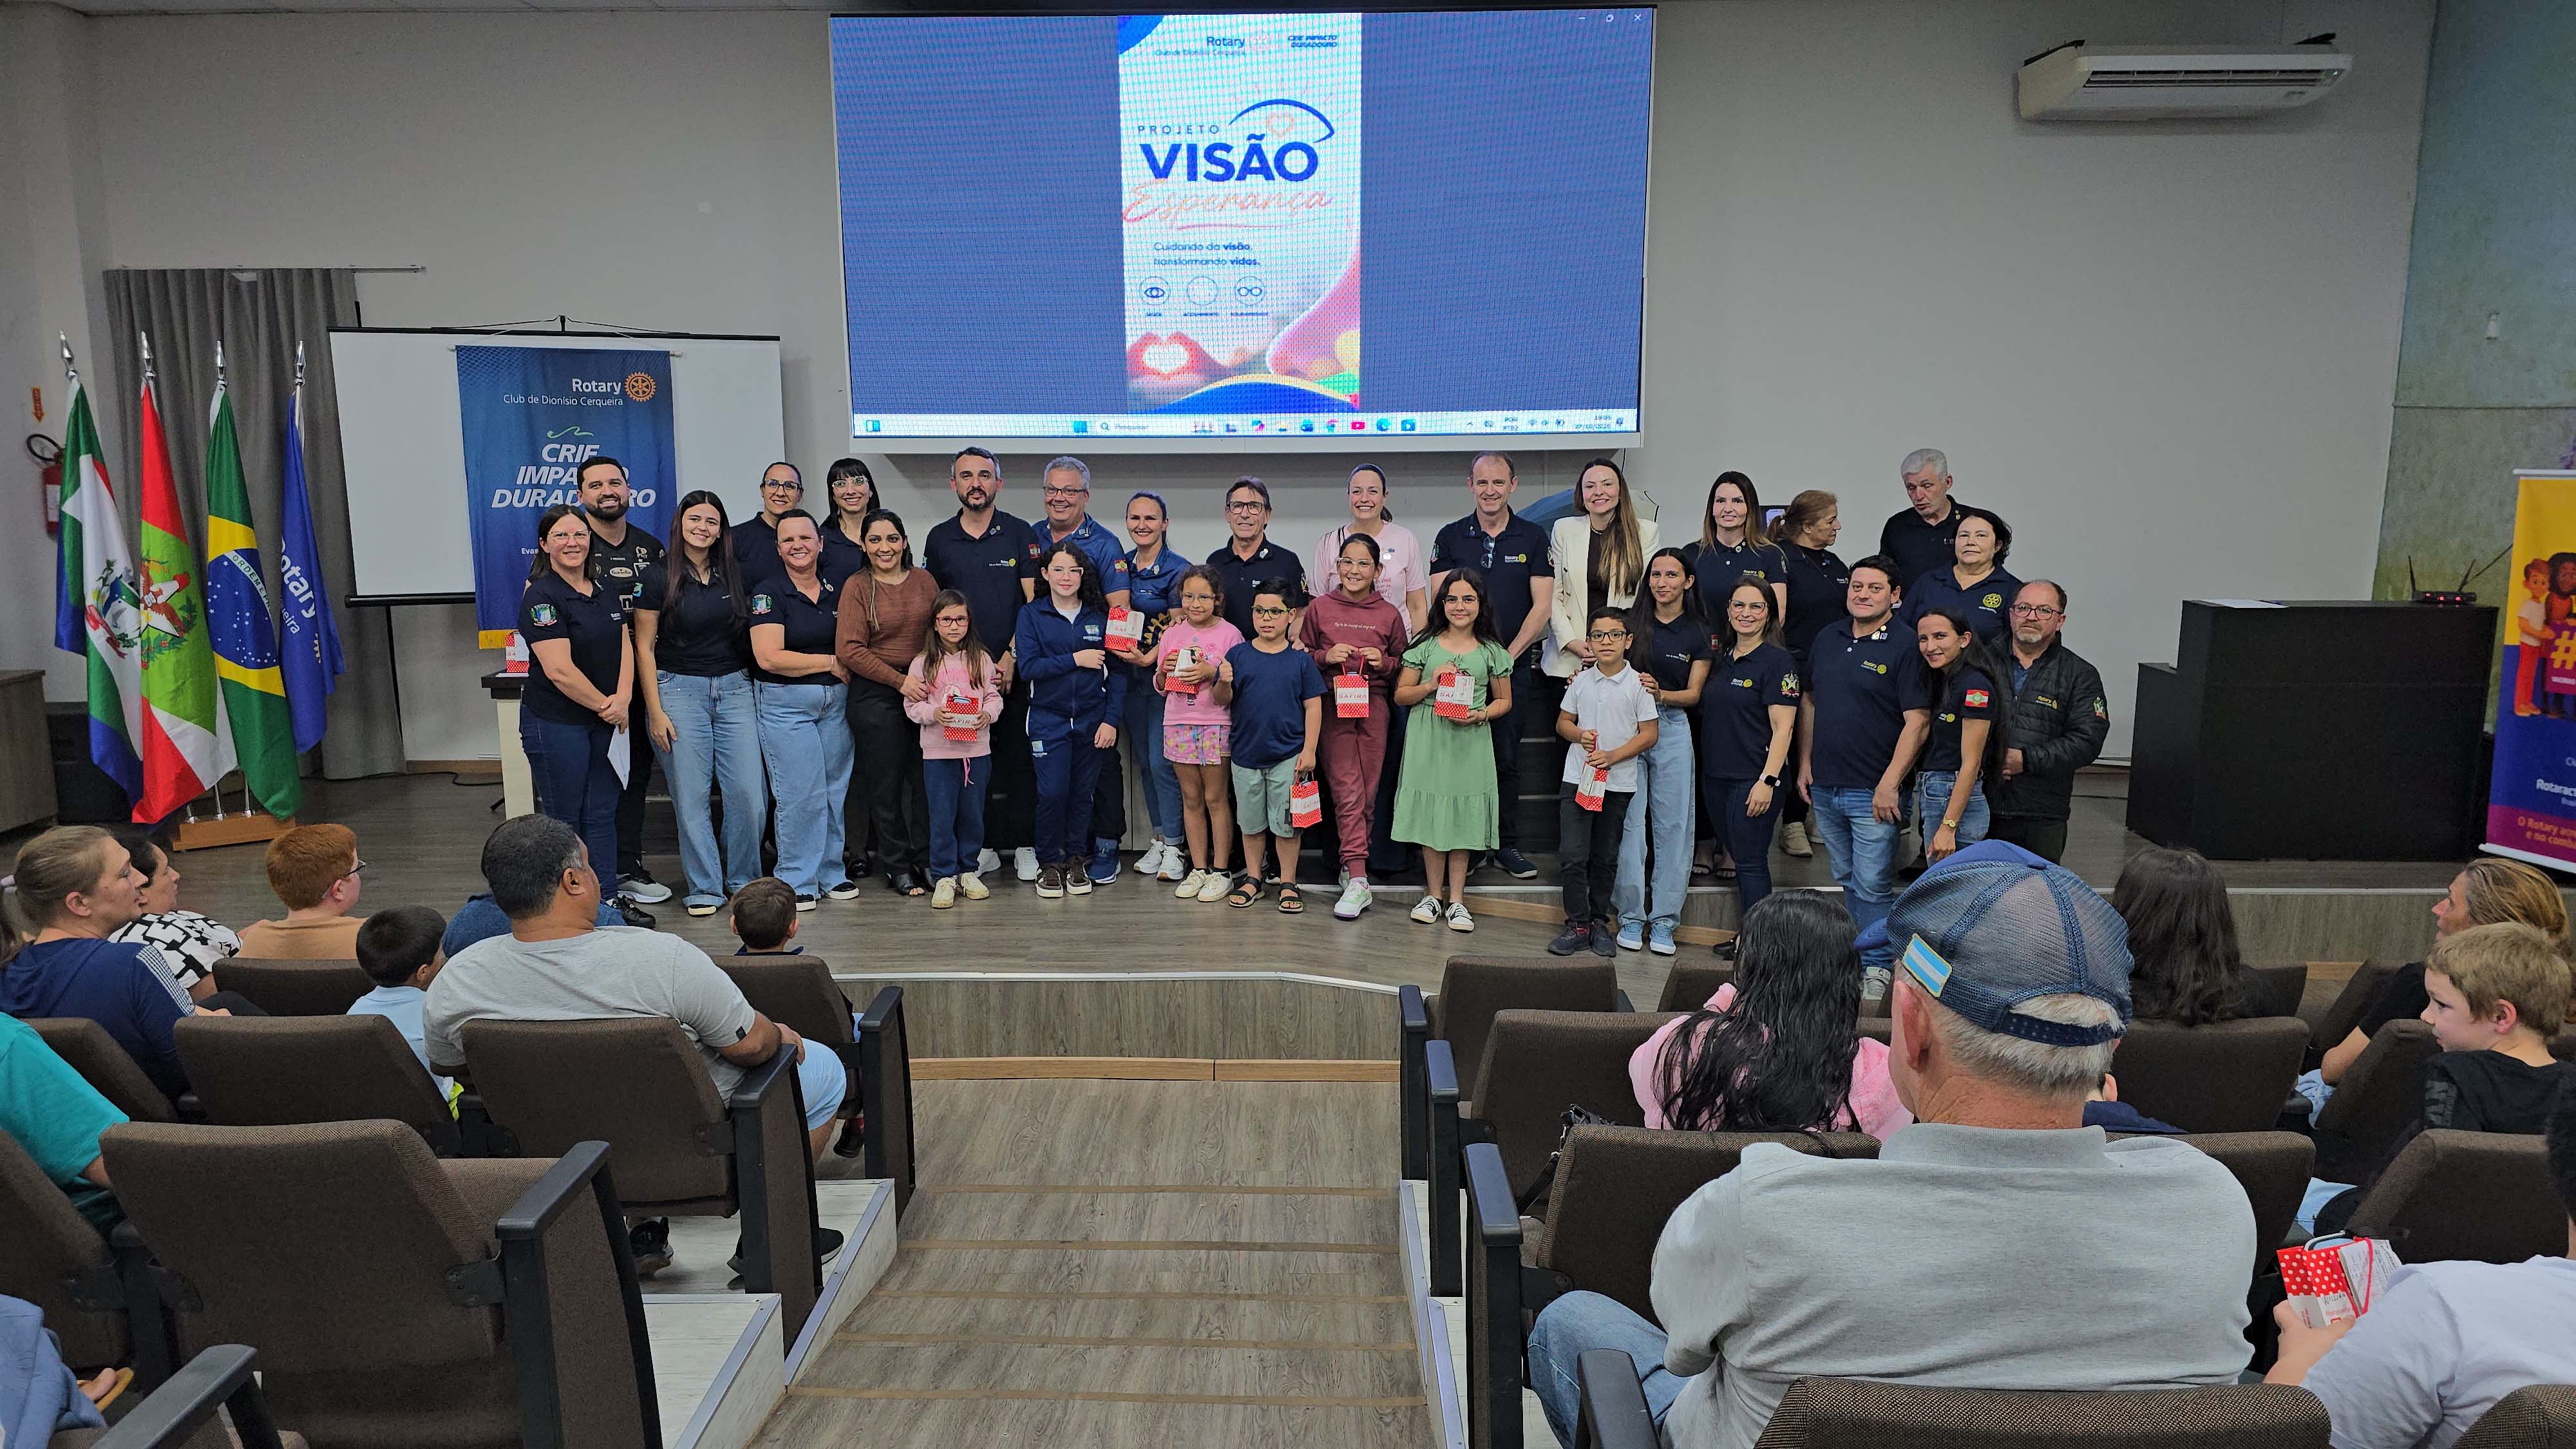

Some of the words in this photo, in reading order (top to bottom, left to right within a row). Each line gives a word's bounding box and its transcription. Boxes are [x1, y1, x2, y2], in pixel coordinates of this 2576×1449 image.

[1206, 36, 1245, 48] Rotary
[1138, 124, 1220, 135] PROJETO
[1140, 133, 1318, 182] VISÃO
[1122, 178, 1334, 228] Esperança
[1153, 242, 1204, 251] Cuidando
[1206, 242, 1220, 251] da
[1154, 257, 1227, 266] transformando
[572, 378, 622, 395] Rotary
[504, 394, 525, 404] Club
[527, 394, 540, 404] de
[542, 395, 578, 406] Dionísio
[580, 397, 623, 407] Cerqueira
[491, 488, 656, 508] DURADRO
[232, 555, 261, 587] ORDEM
[281, 535, 316, 618] otary
[2527, 818, 2559, 836] Rotary
